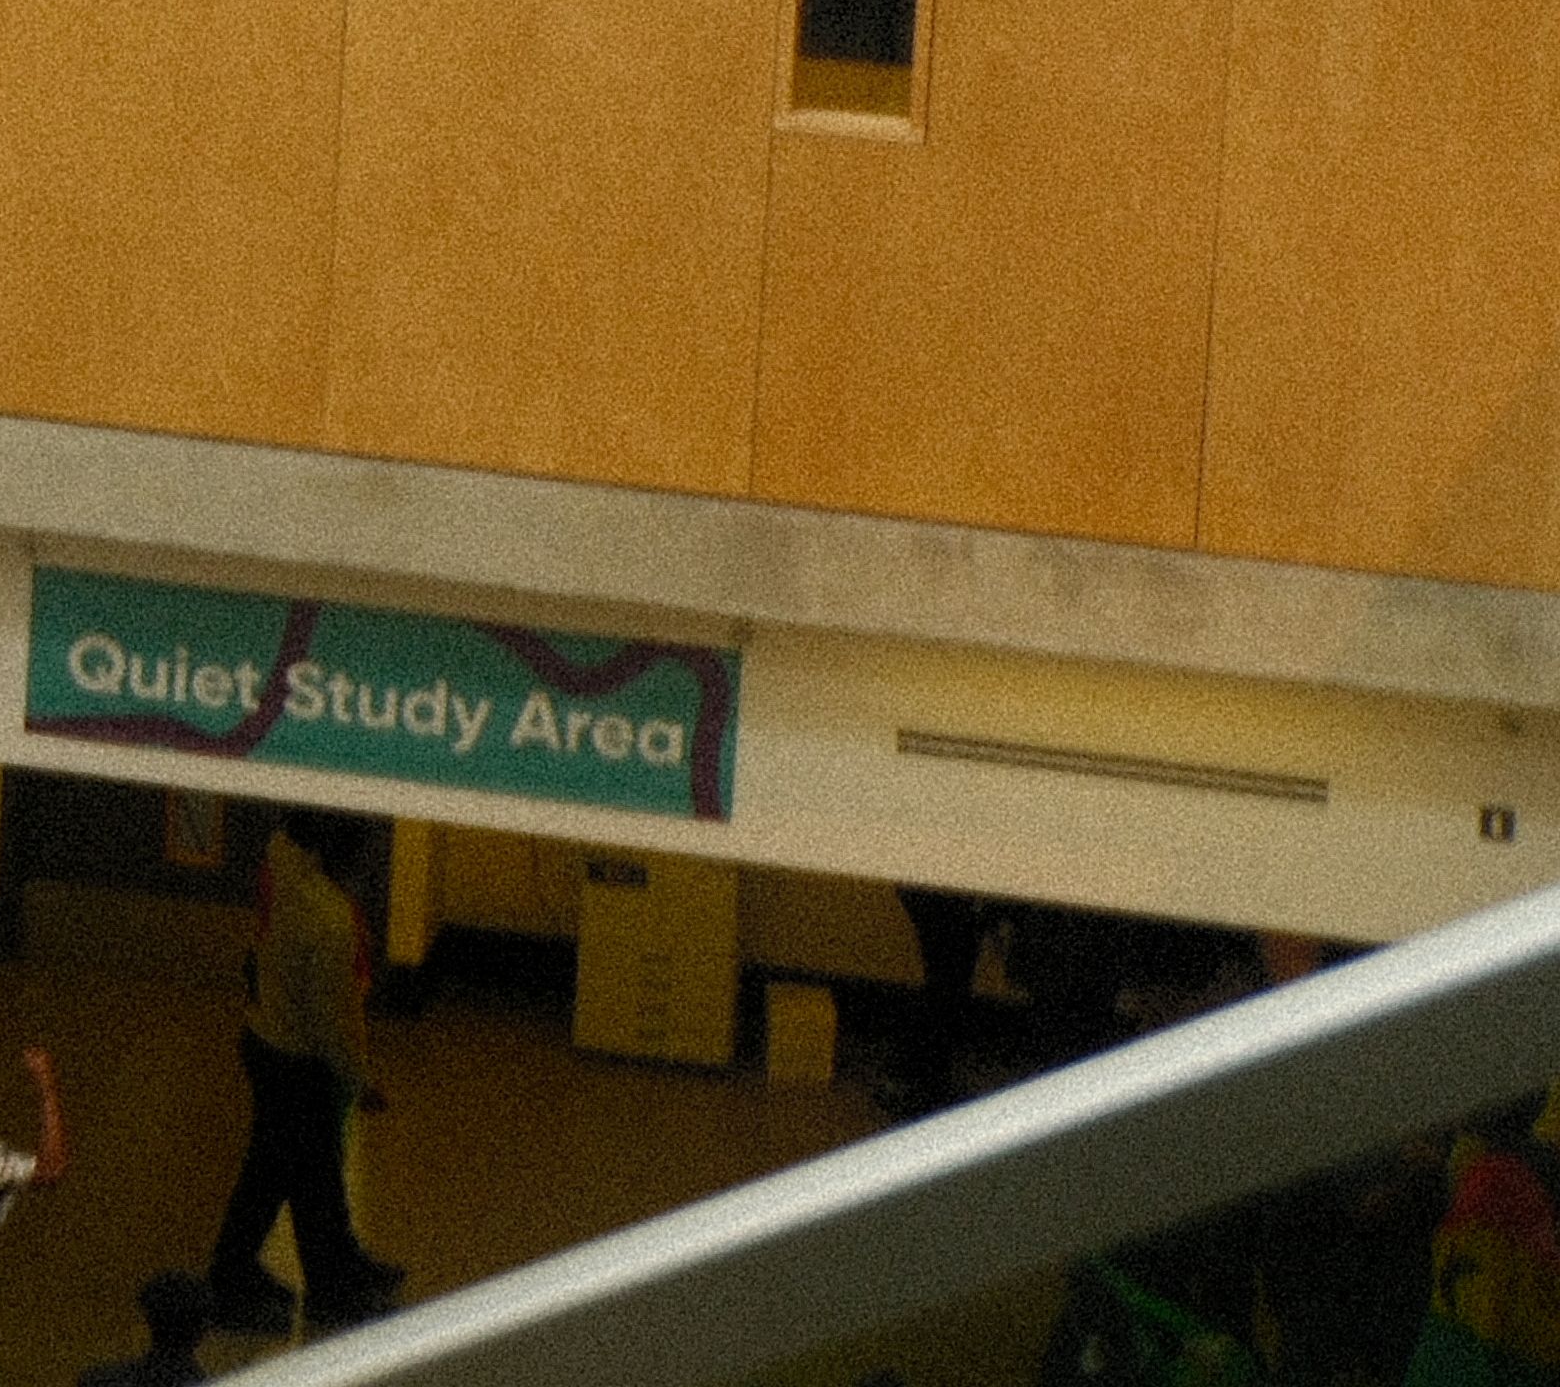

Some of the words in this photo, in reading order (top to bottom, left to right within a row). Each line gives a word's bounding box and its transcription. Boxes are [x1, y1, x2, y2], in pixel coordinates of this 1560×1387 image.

[66, 634, 263, 711] Quiet
[282, 661, 491, 753] Study
[510, 691, 685, 767] Area
